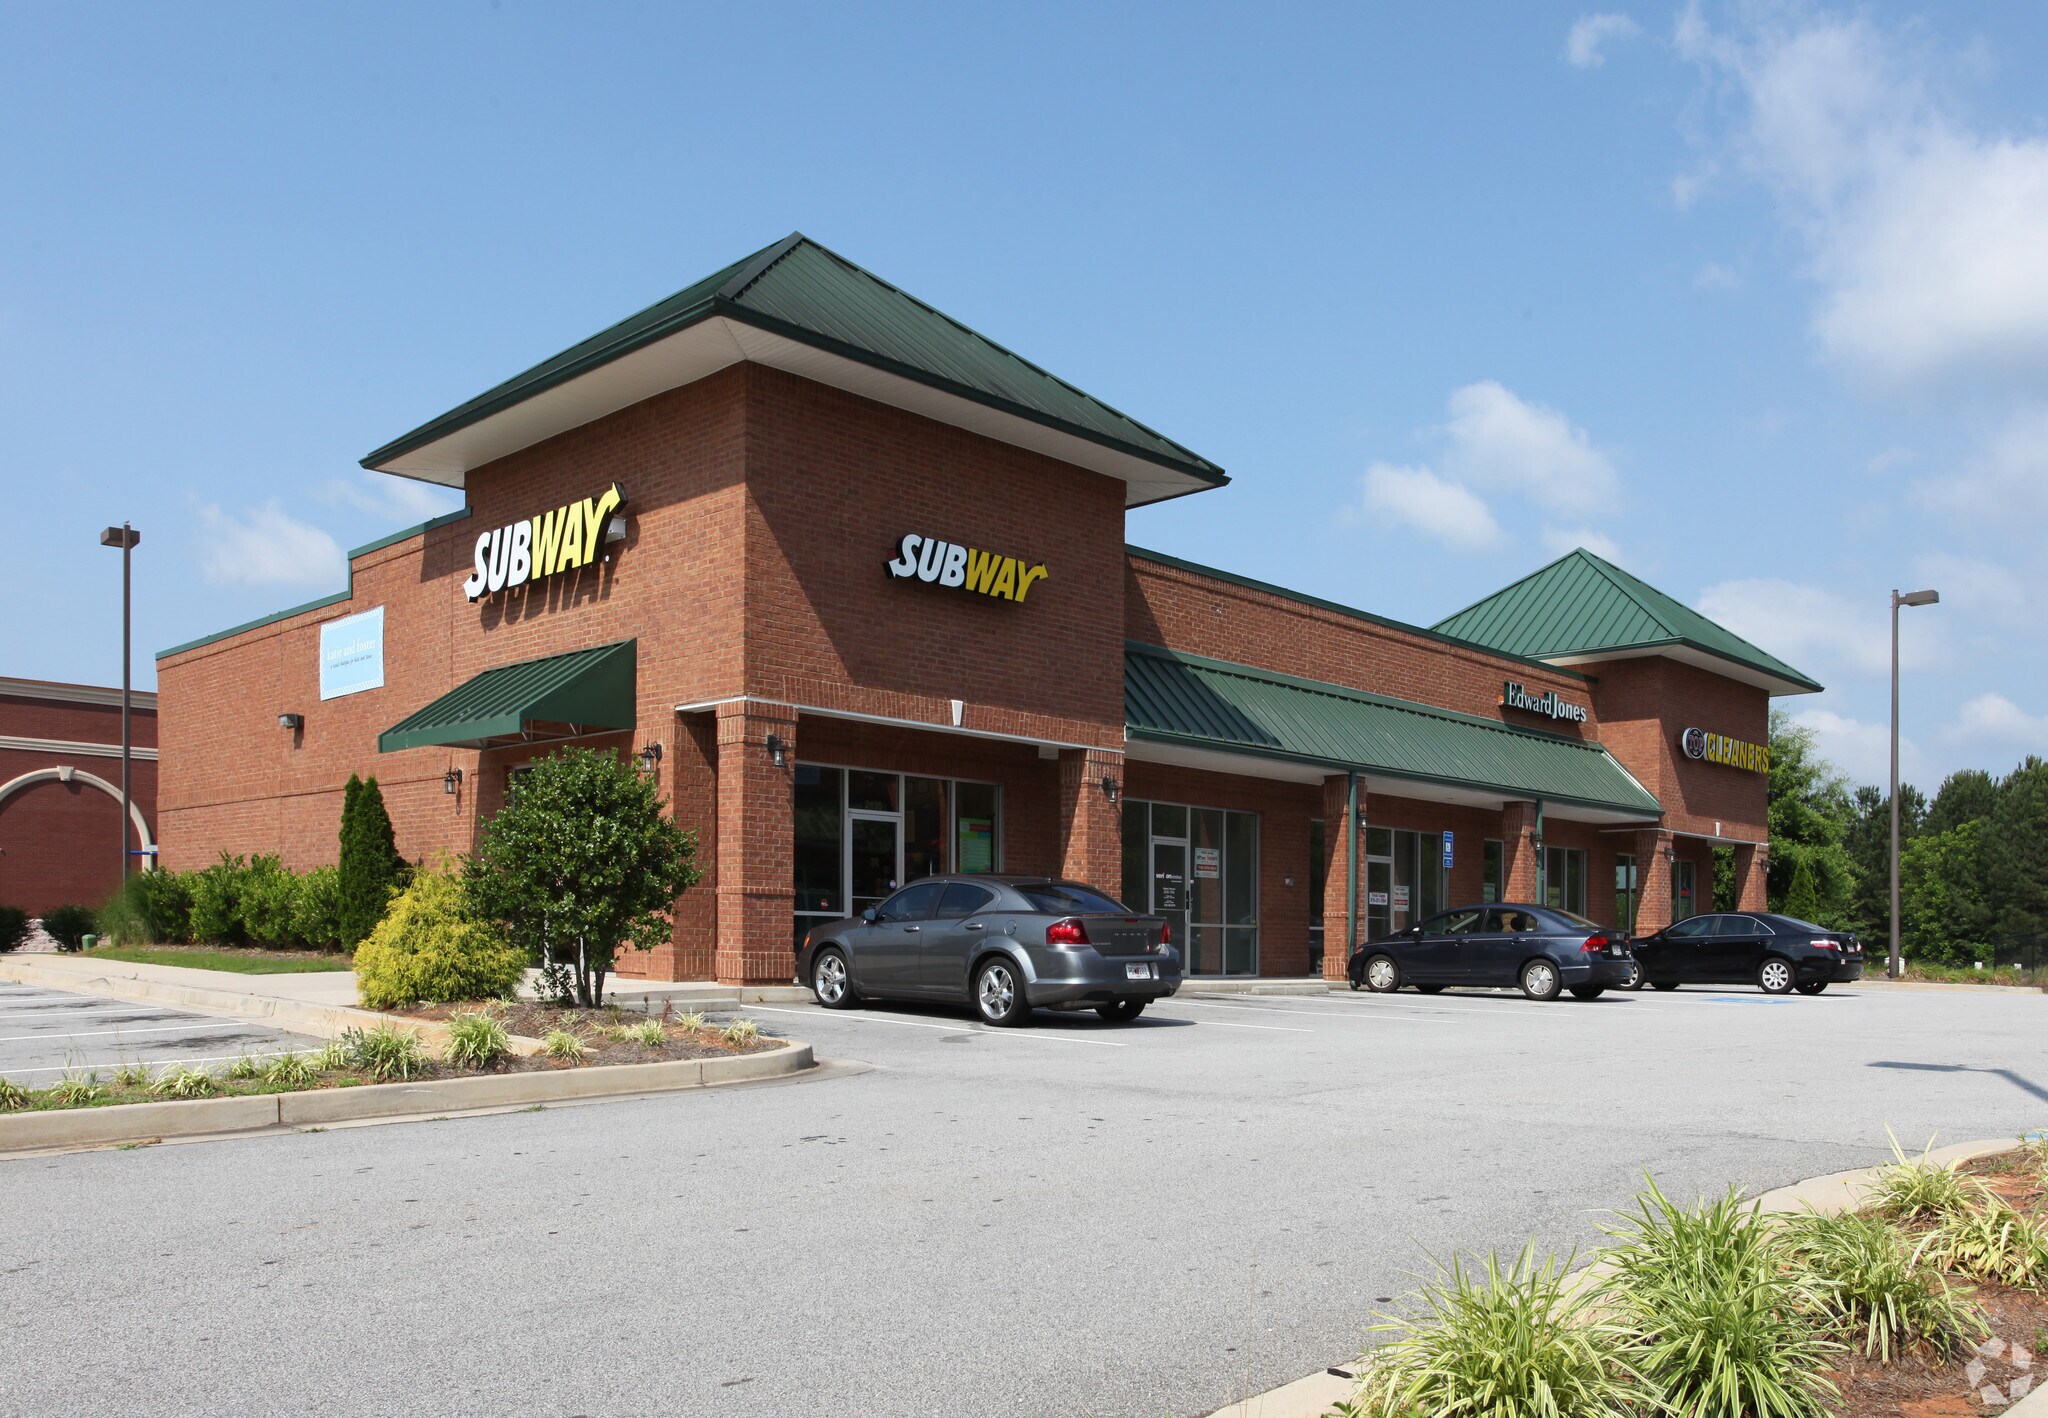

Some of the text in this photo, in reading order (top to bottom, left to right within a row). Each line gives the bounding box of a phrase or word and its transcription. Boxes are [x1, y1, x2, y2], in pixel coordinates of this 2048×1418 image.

[463, 482, 622, 603] SUBWAY
[888, 534, 1049, 603] SUBWAY
[356, 638, 376, 653] foster
[1508, 681, 1587, 722] Edward Jones
[1707, 732, 1770, 774] CLEANERS
